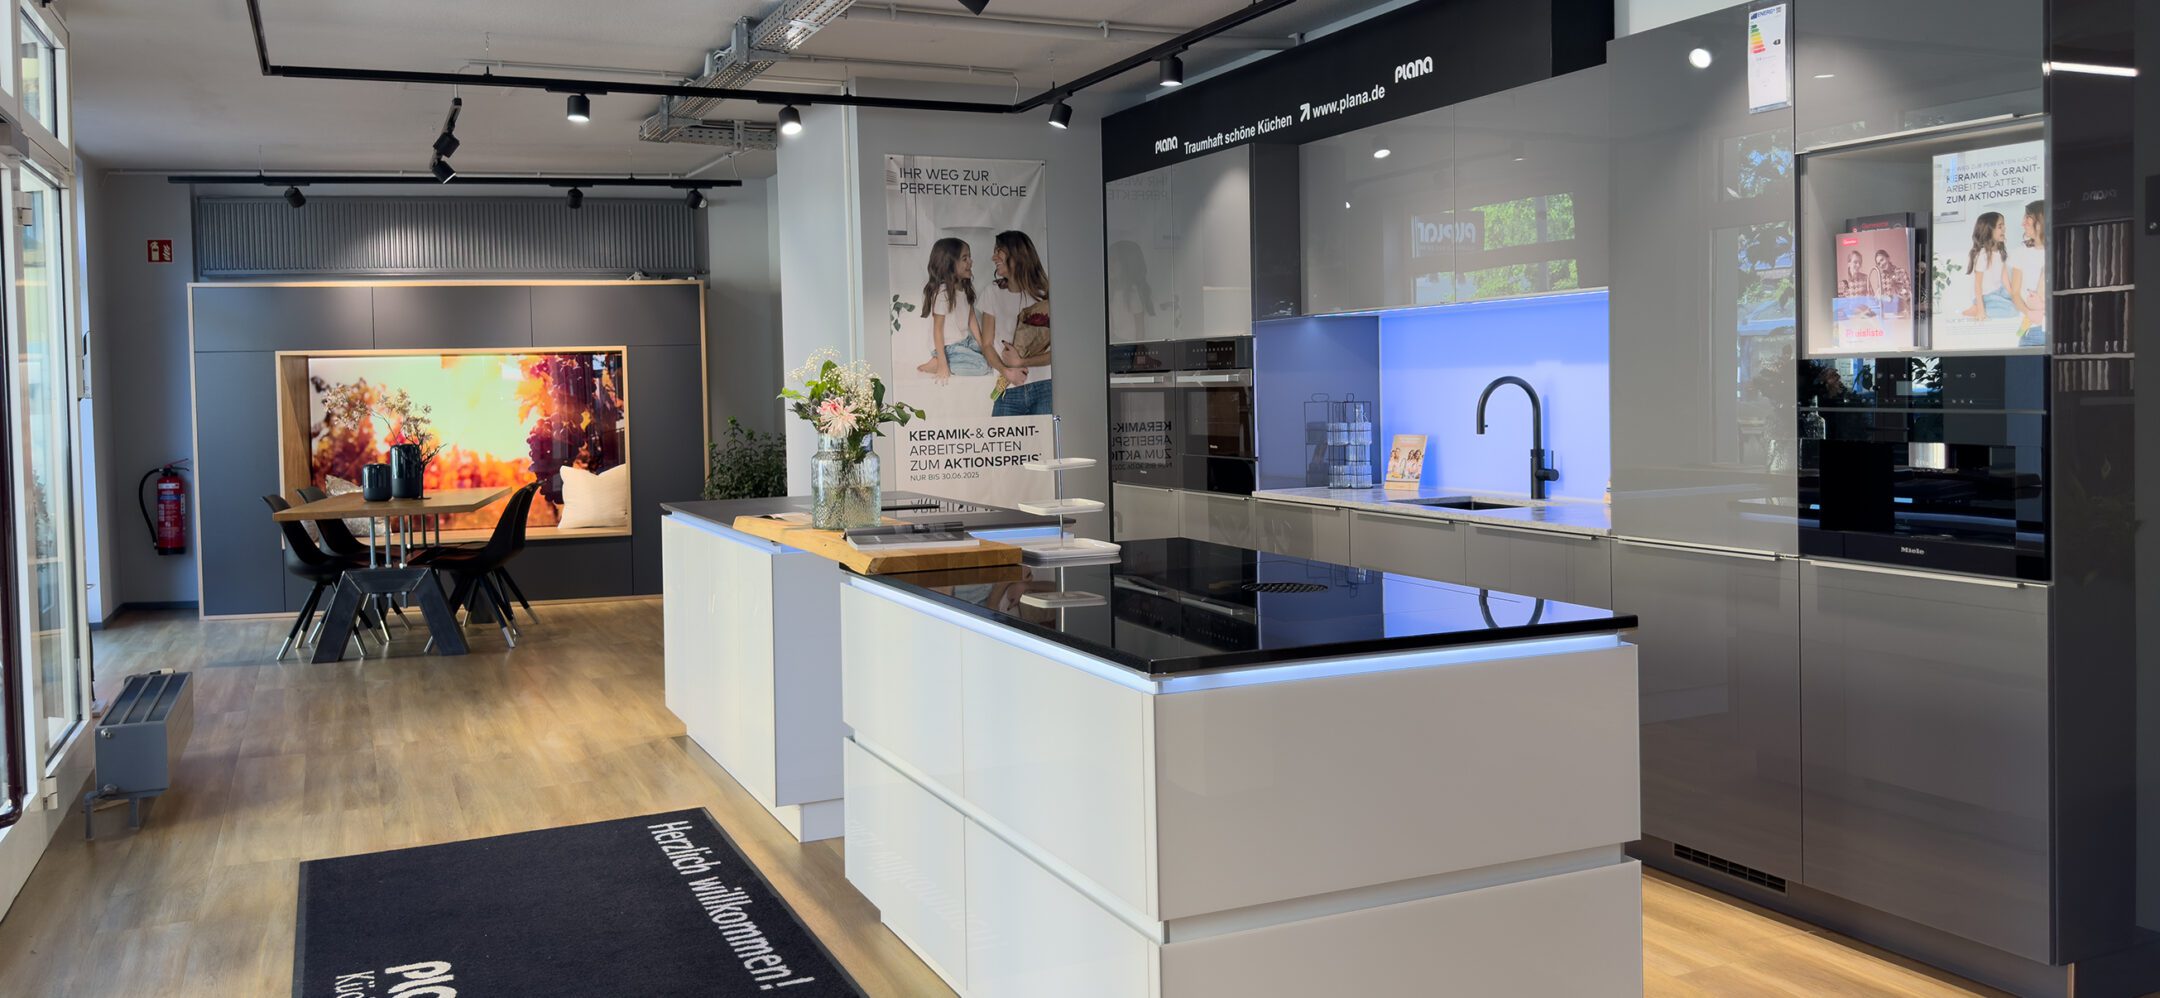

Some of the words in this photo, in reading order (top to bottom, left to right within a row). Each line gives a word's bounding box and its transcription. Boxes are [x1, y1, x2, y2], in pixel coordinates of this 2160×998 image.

[1394, 56, 1433, 83] plana
[1312, 84, 1386, 118] www.plana.de
[1184, 132, 1224, 155] Traumhaft
[1225, 126, 1256, 144] schöne
[1258, 114, 1293, 135] Küchen
[1155, 136, 1178, 154] plana
[900, 167, 922, 180] IHR
[926, 169, 959, 181] WEG
[963, 169, 990, 182] ZUR
[2001, 163, 2041, 176] GRANIT-
[900, 183, 978, 196] PERFEKTEN
[982, 183, 1027, 197] KÜCHE
[1946, 177, 2025, 194] ARBEITSPLATTEN
[1946, 194, 1967, 204] ZUM
[988, 425, 1039, 438] GRANIT-
[909, 440, 1022, 456] ARBEITSPLATTEN
[910, 459, 940, 472] ZUM
[928, 473, 940, 481] BIS
[941, 471, 980, 480] 30.06.2025
[1900, 546, 1925, 555] Miele
[647, 820, 722, 875] Herzlich
[688, 876, 816, 990] willkommen!
